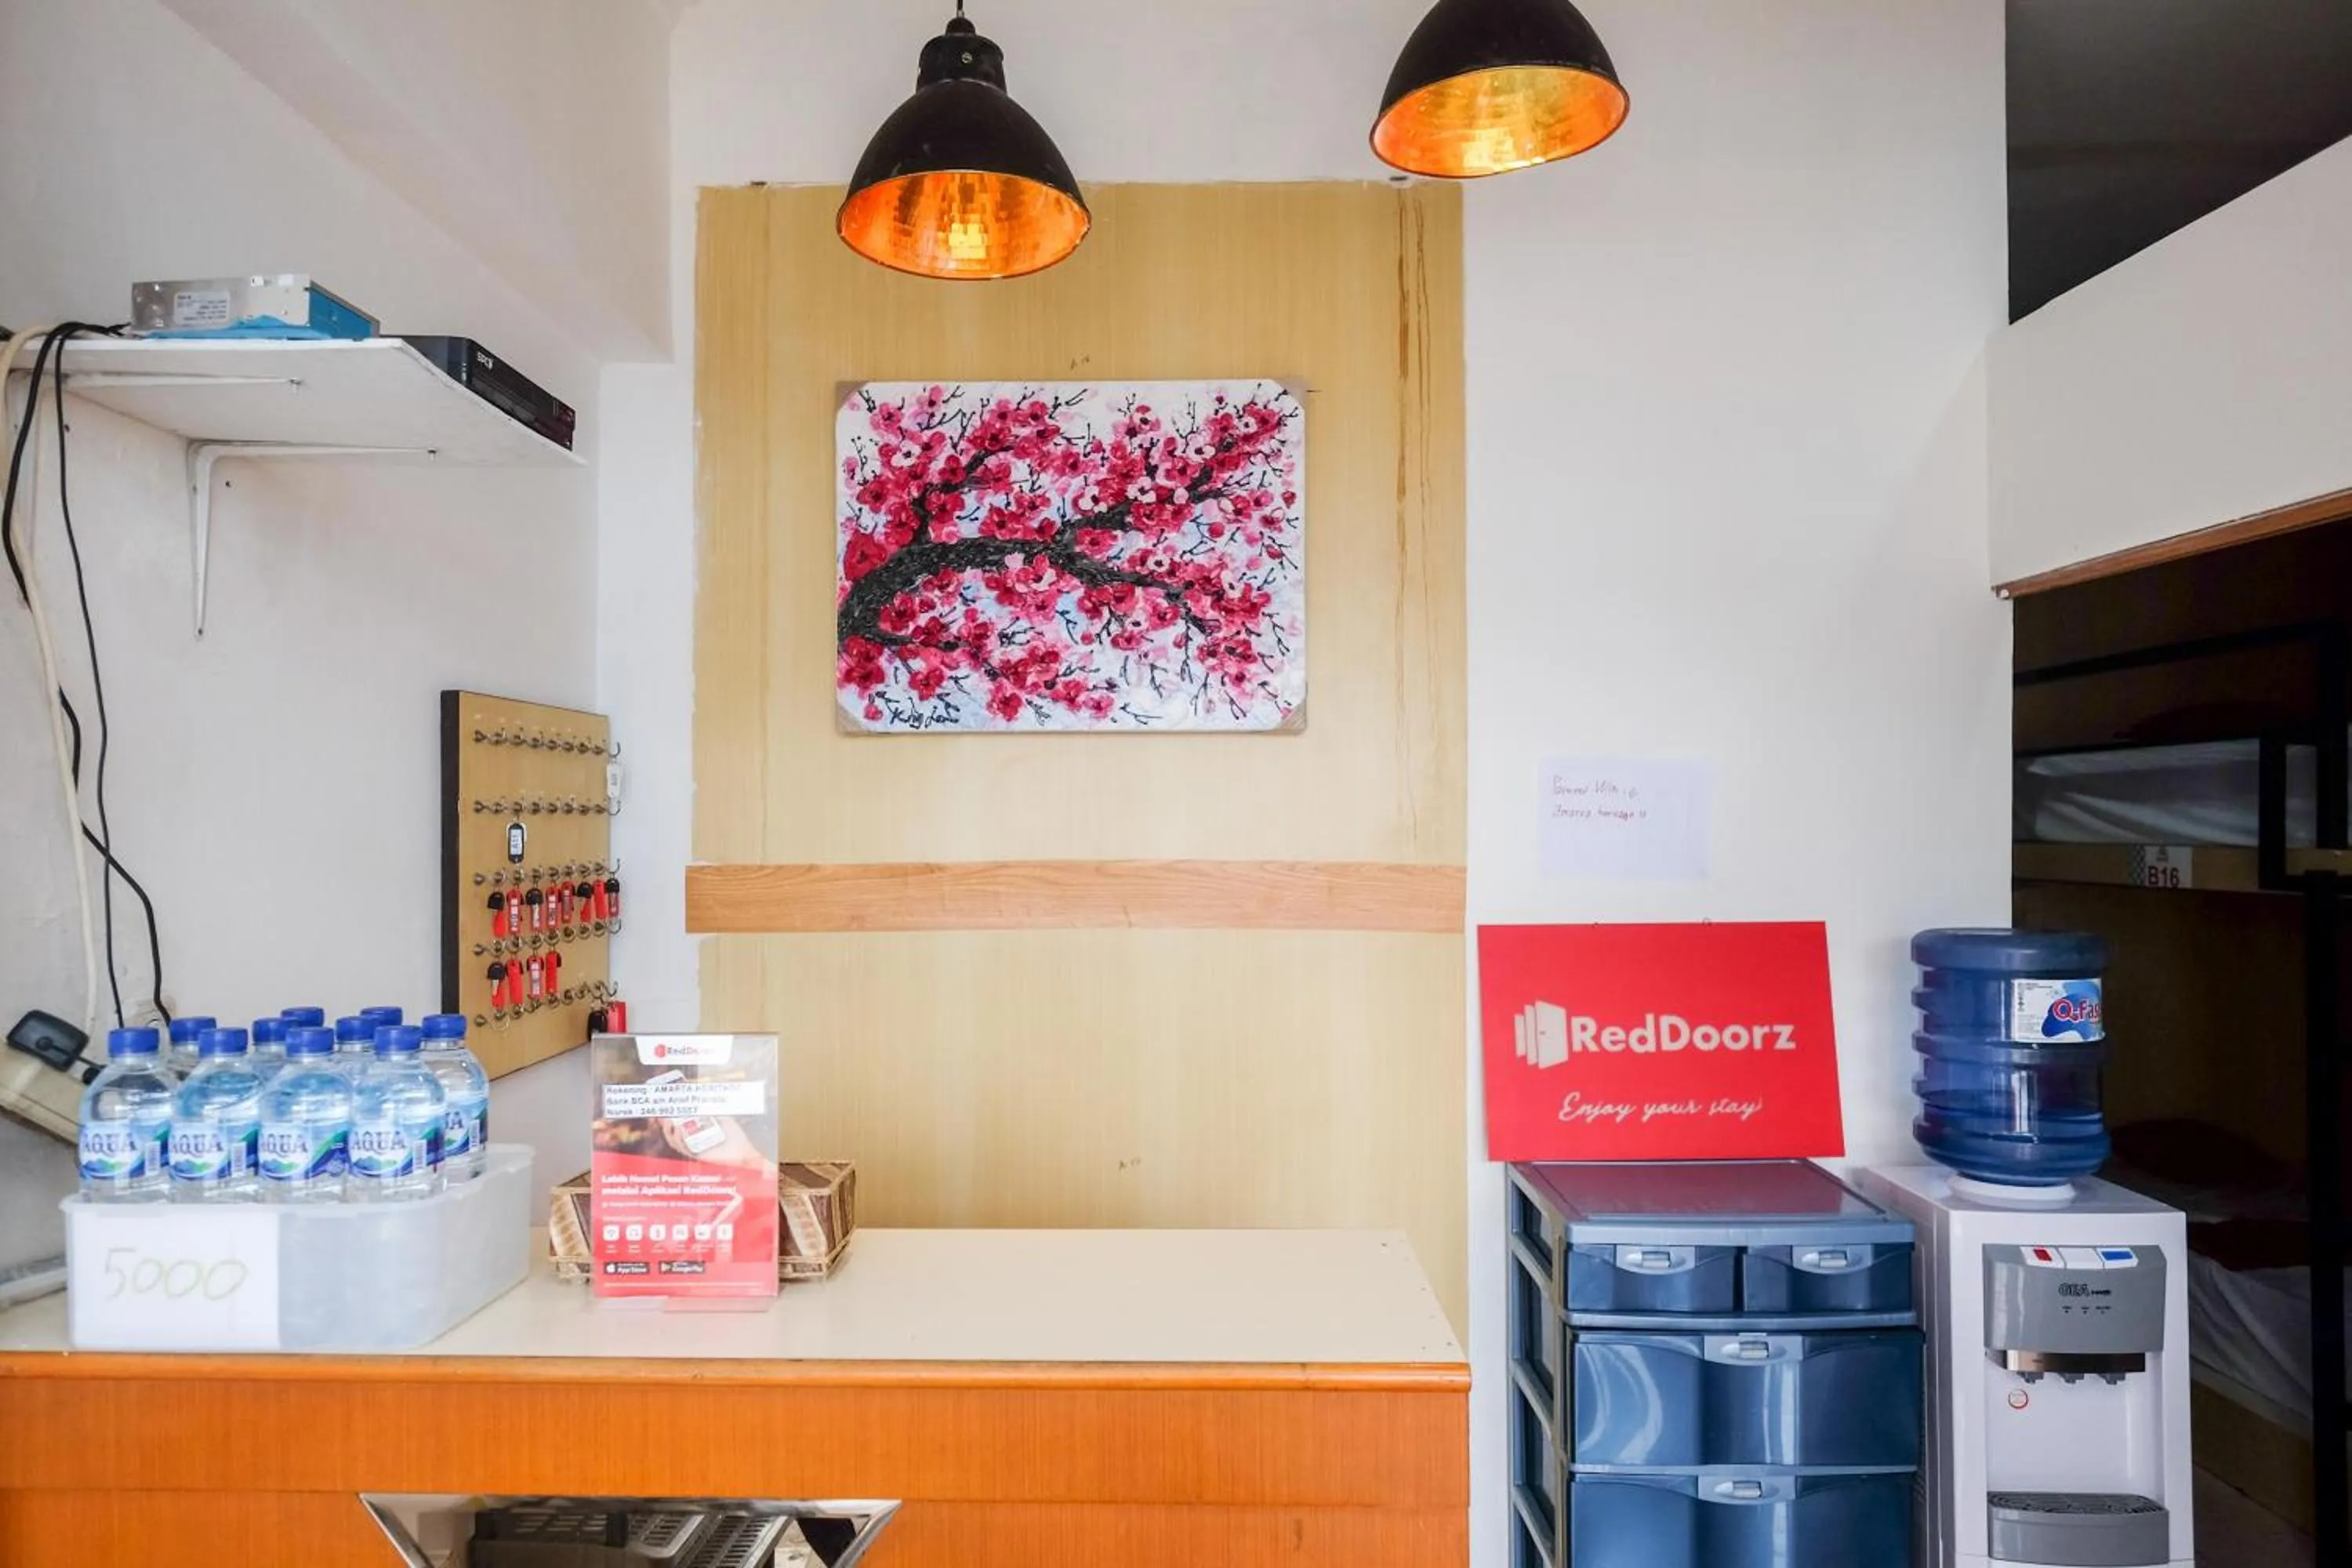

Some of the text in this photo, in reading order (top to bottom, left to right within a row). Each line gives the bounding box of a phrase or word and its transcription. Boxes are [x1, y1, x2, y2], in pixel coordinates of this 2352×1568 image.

[2148, 866, 2180, 888] B16
[1570, 1013, 1797, 1053] RedDoorz
[1558, 1091, 1762, 1123] Enjoy your stay
[84, 1133, 138, 1158] AQUA
[172, 1134, 224, 1158] AQUA
[351, 1131, 406, 1155] AQUA
[103, 1247, 250, 1303] 5000
